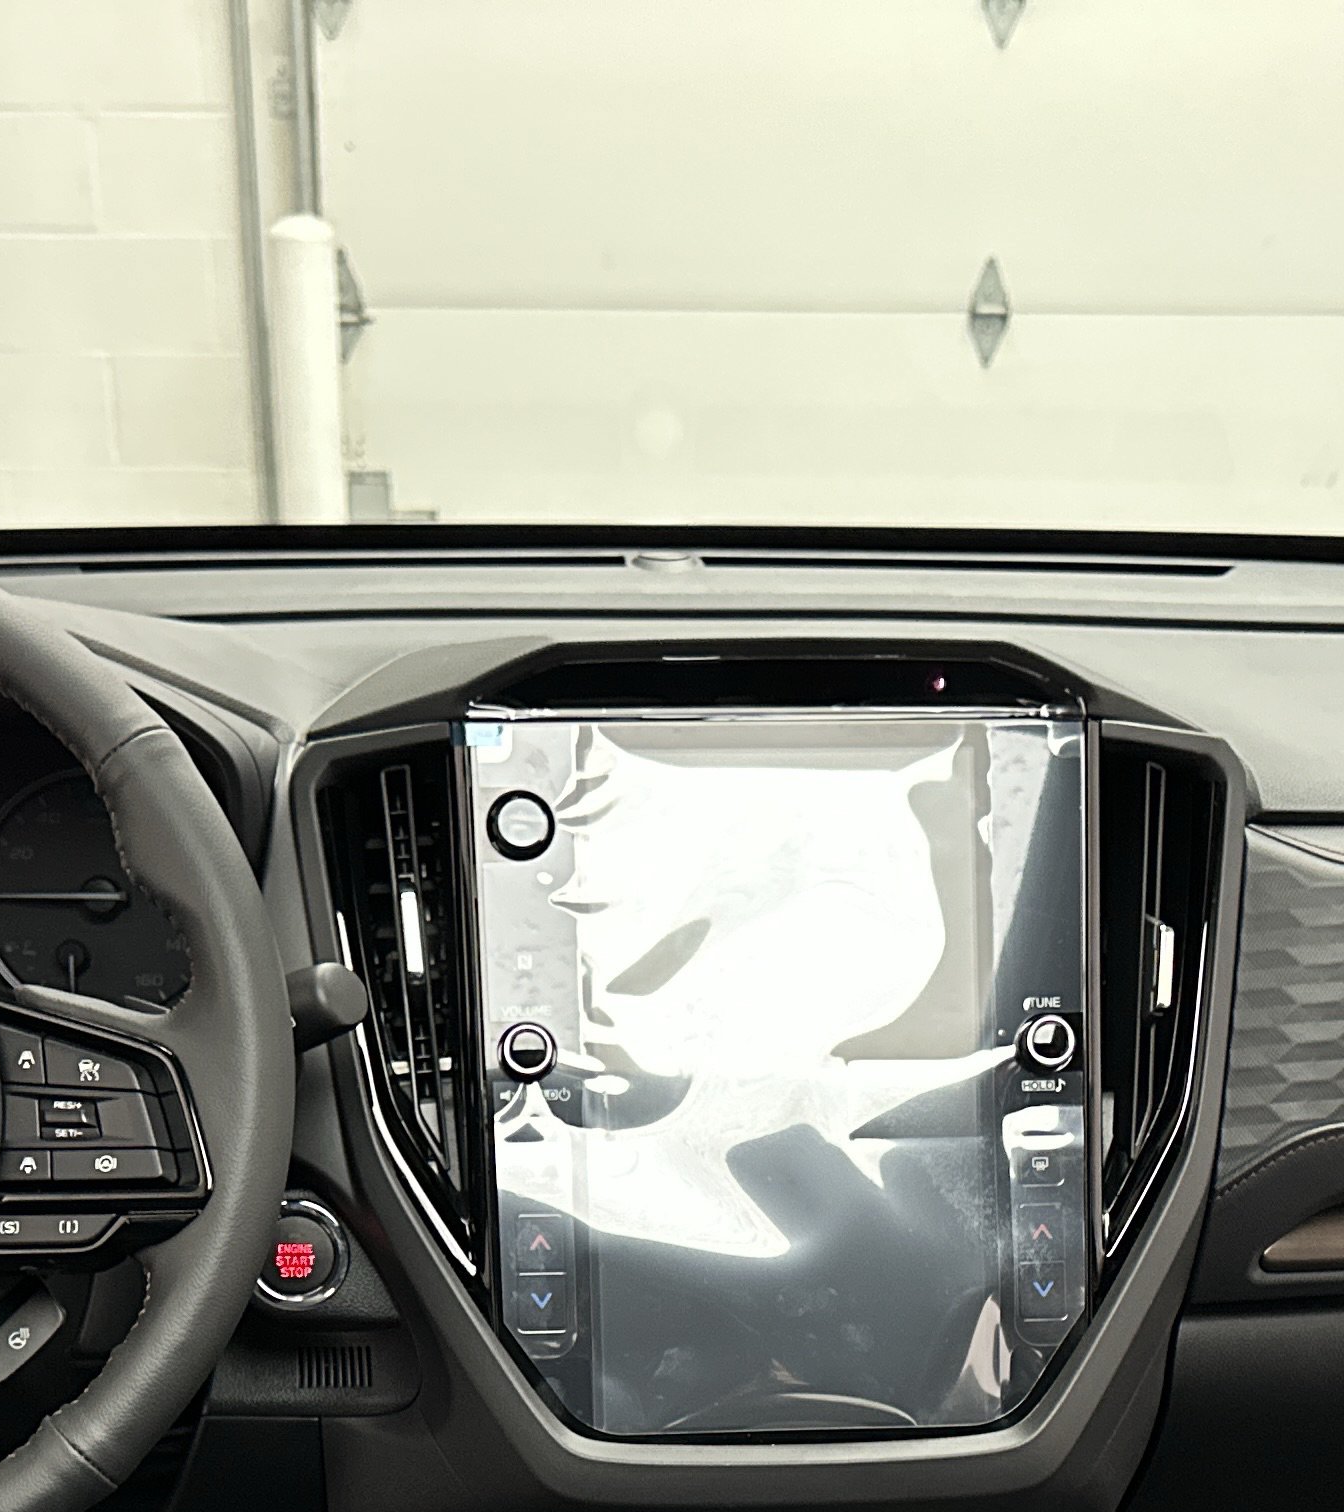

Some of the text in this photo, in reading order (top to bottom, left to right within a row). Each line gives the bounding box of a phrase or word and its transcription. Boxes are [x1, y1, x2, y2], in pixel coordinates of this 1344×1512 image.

[1028, 997, 1061, 1008] TUNE
[500, 1006, 552, 1018] VOLUME
[1022, 1080, 1054, 1091] HOLD
[278, 1244, 313, 1254] ENGINE
[276, 1255, 315, 1266] START
[280, 1267, 312, 1278] STOP
